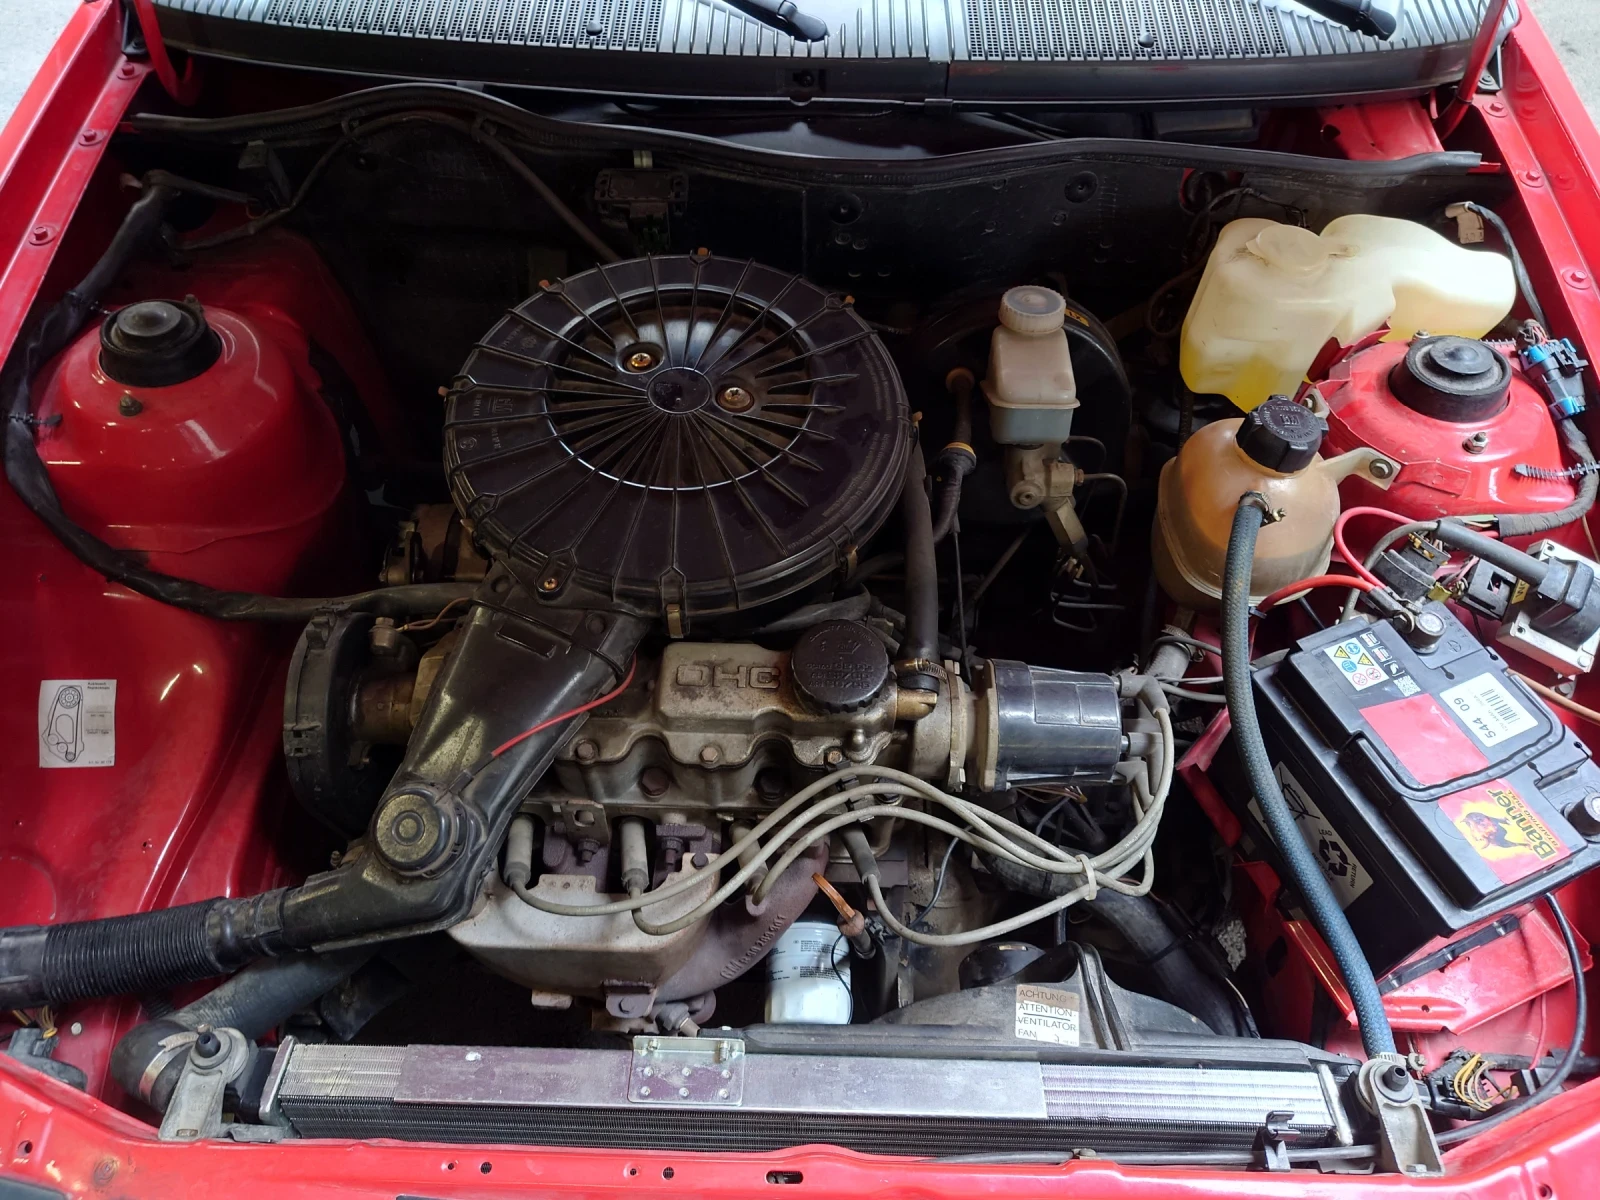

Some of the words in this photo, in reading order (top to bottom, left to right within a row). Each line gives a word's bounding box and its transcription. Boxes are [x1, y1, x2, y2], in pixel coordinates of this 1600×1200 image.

[676, 664, 780, 689] OHC
[1453, 697, 1470, 712] 09
[1472, 717, 1496, 739] 544
[1487, 788, 1557, 860] Banner
[1318, 828, 1333, 836] LEAD
[1349, 862, 1358, 889] RETURN
[1018, 989, 1067, 1002] ACHTUNG
[1018, 1003, 1073, 1017] ATTENTION
[1017, 1016, 1076, 1031] VENTILATOR
[1018, 1028, 1037, 1038] FAN
